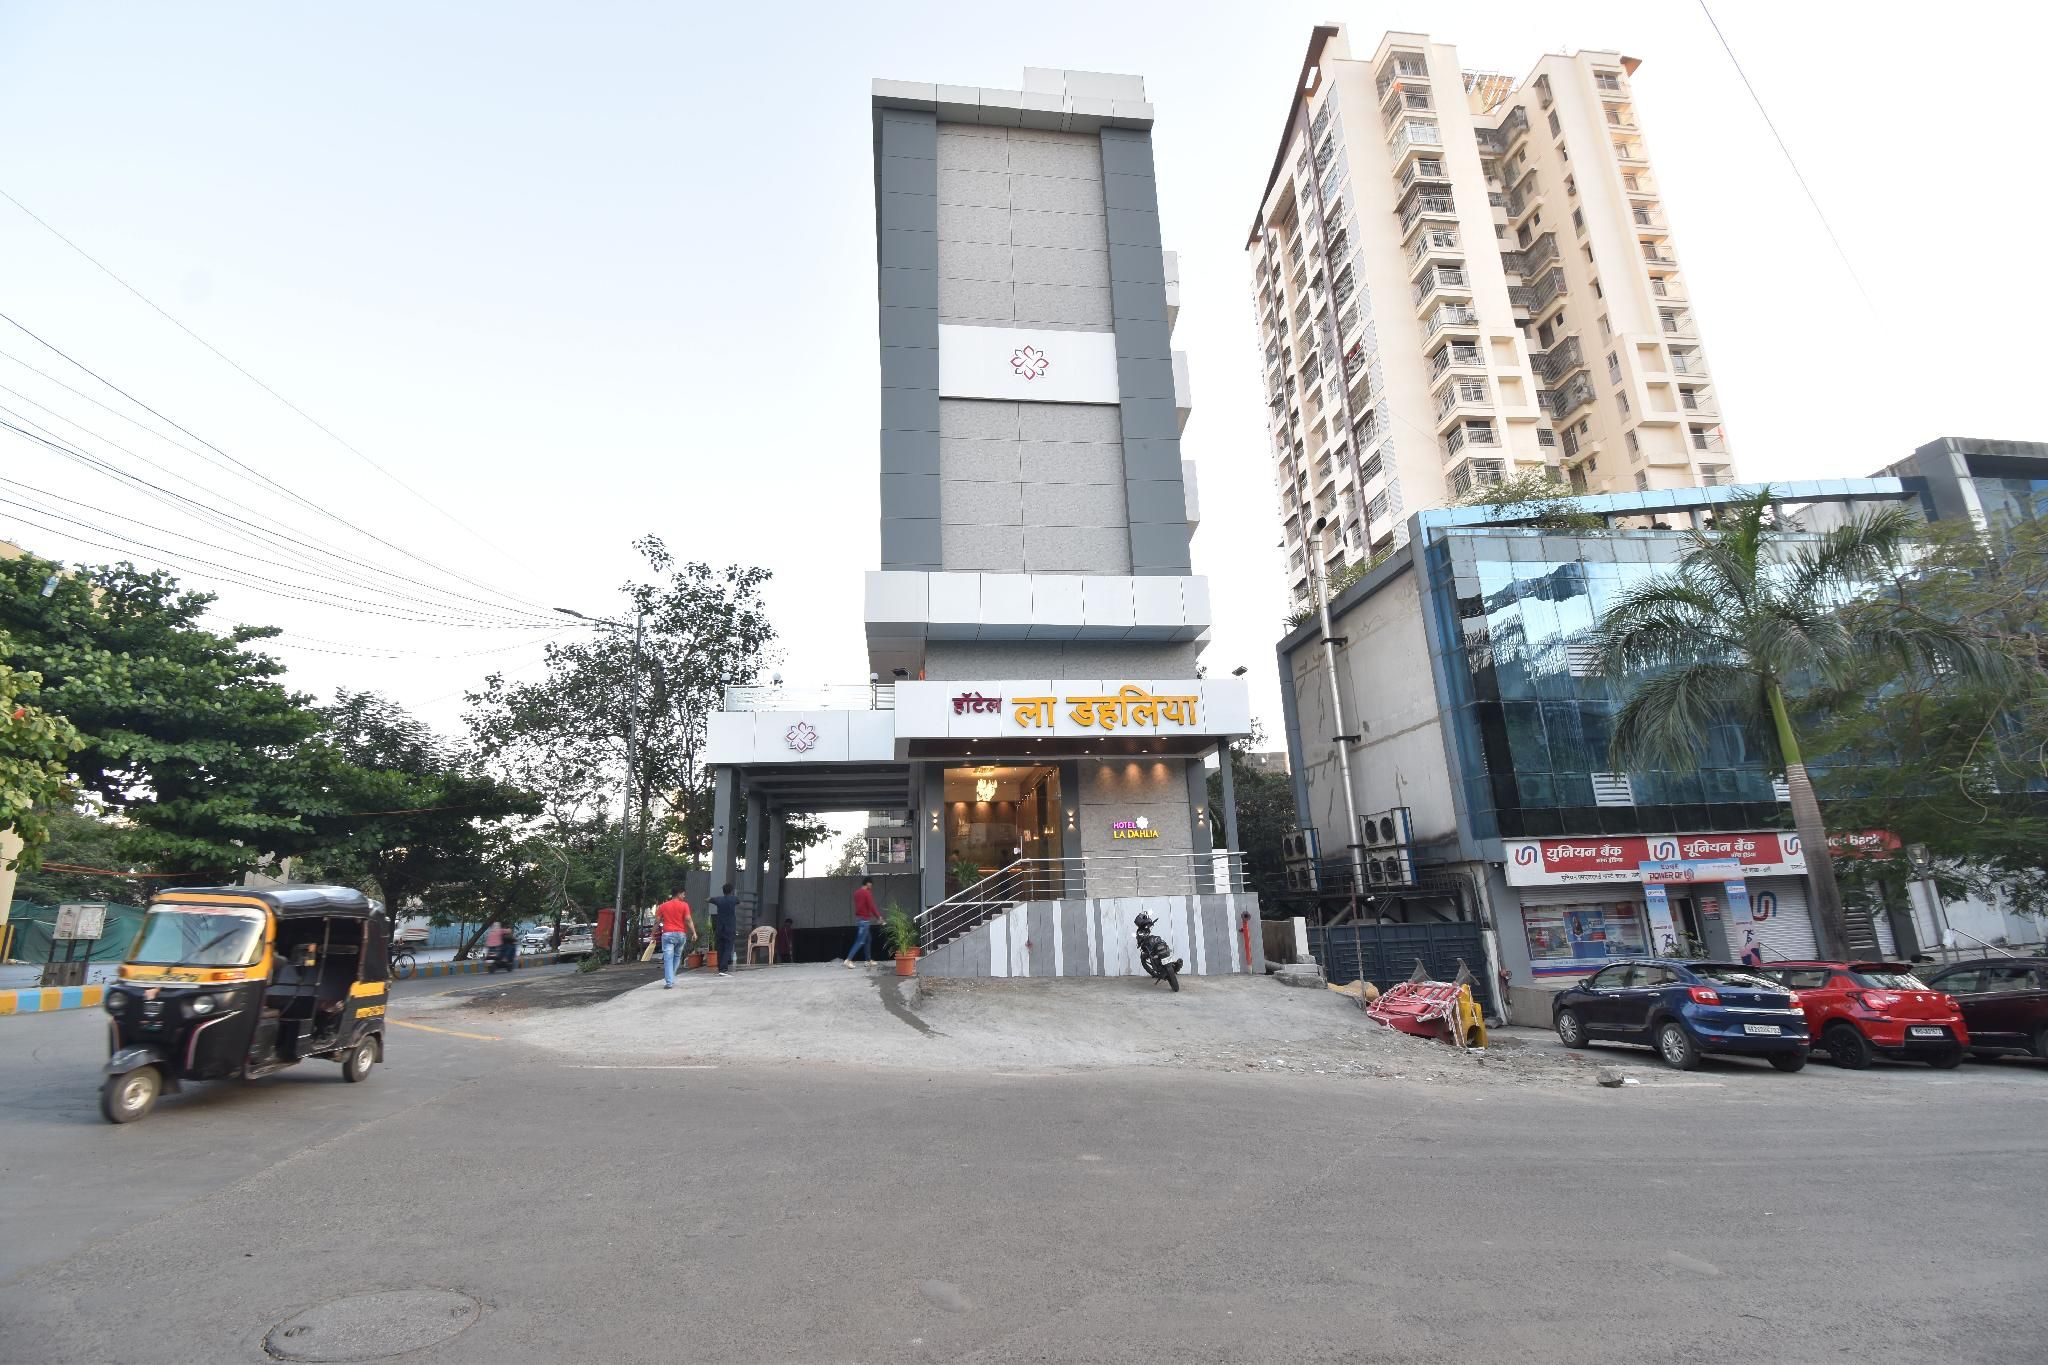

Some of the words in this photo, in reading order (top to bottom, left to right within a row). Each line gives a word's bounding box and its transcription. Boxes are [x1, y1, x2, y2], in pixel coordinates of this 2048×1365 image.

[952, 691, 1002, 715] हॉटेल
[1012, 697, 1057, 728] ला
[1066, 684, 1198, 730] डहलिया
[1113, 831, 1126, 839] LA
[1127, 830, 1159, 839] DAHLIA
[1546, 844, 1597, 862] युनियन
[1683, 840, 1732, 857] यूनियन
[1648, 871, 1674, 880] POWER
[1674, 871, 1683, 879] OF
